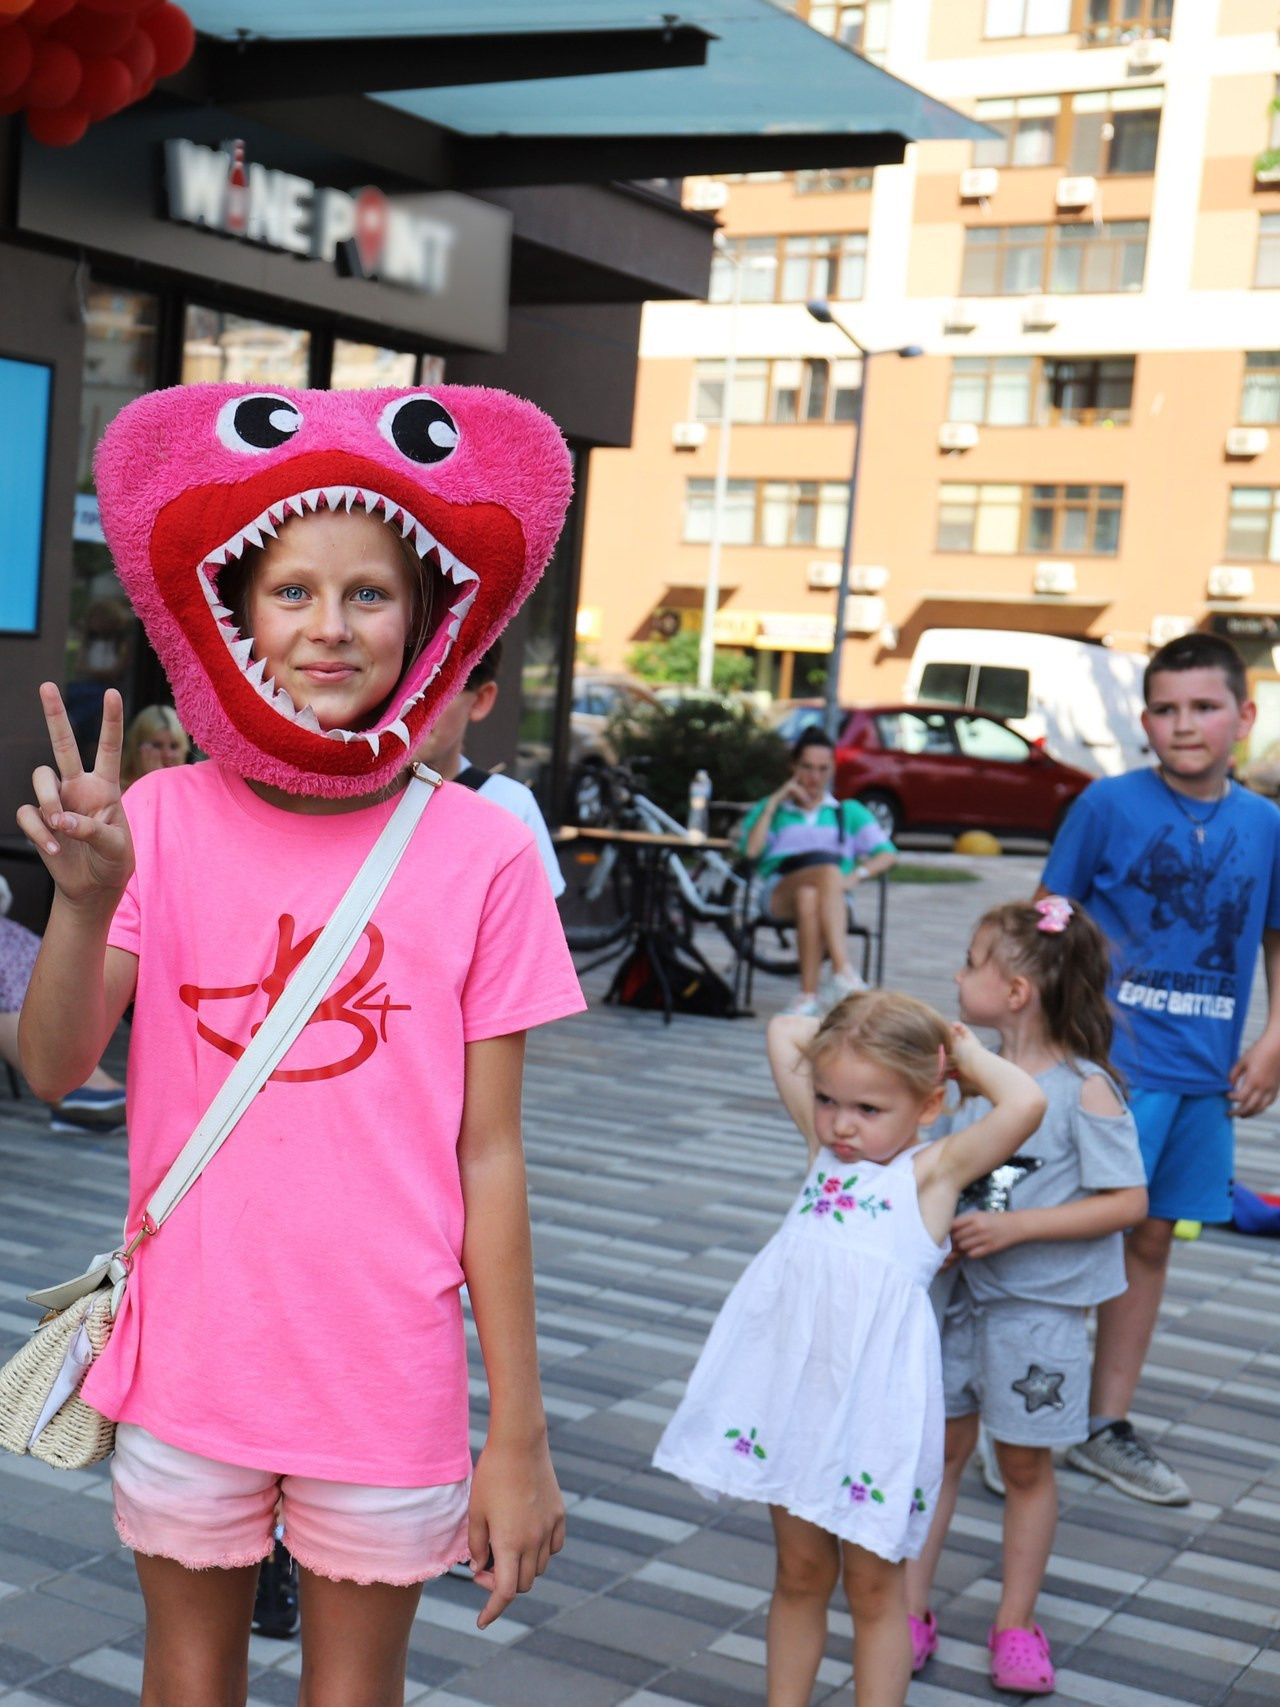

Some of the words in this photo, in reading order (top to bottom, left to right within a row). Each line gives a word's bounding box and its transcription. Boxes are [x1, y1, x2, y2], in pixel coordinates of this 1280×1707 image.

[170, 138, 316, 256] WINE
[1118, 980, 1169, 1011] EPIC
[1167, 990, 1236, 1021] BATTLES
